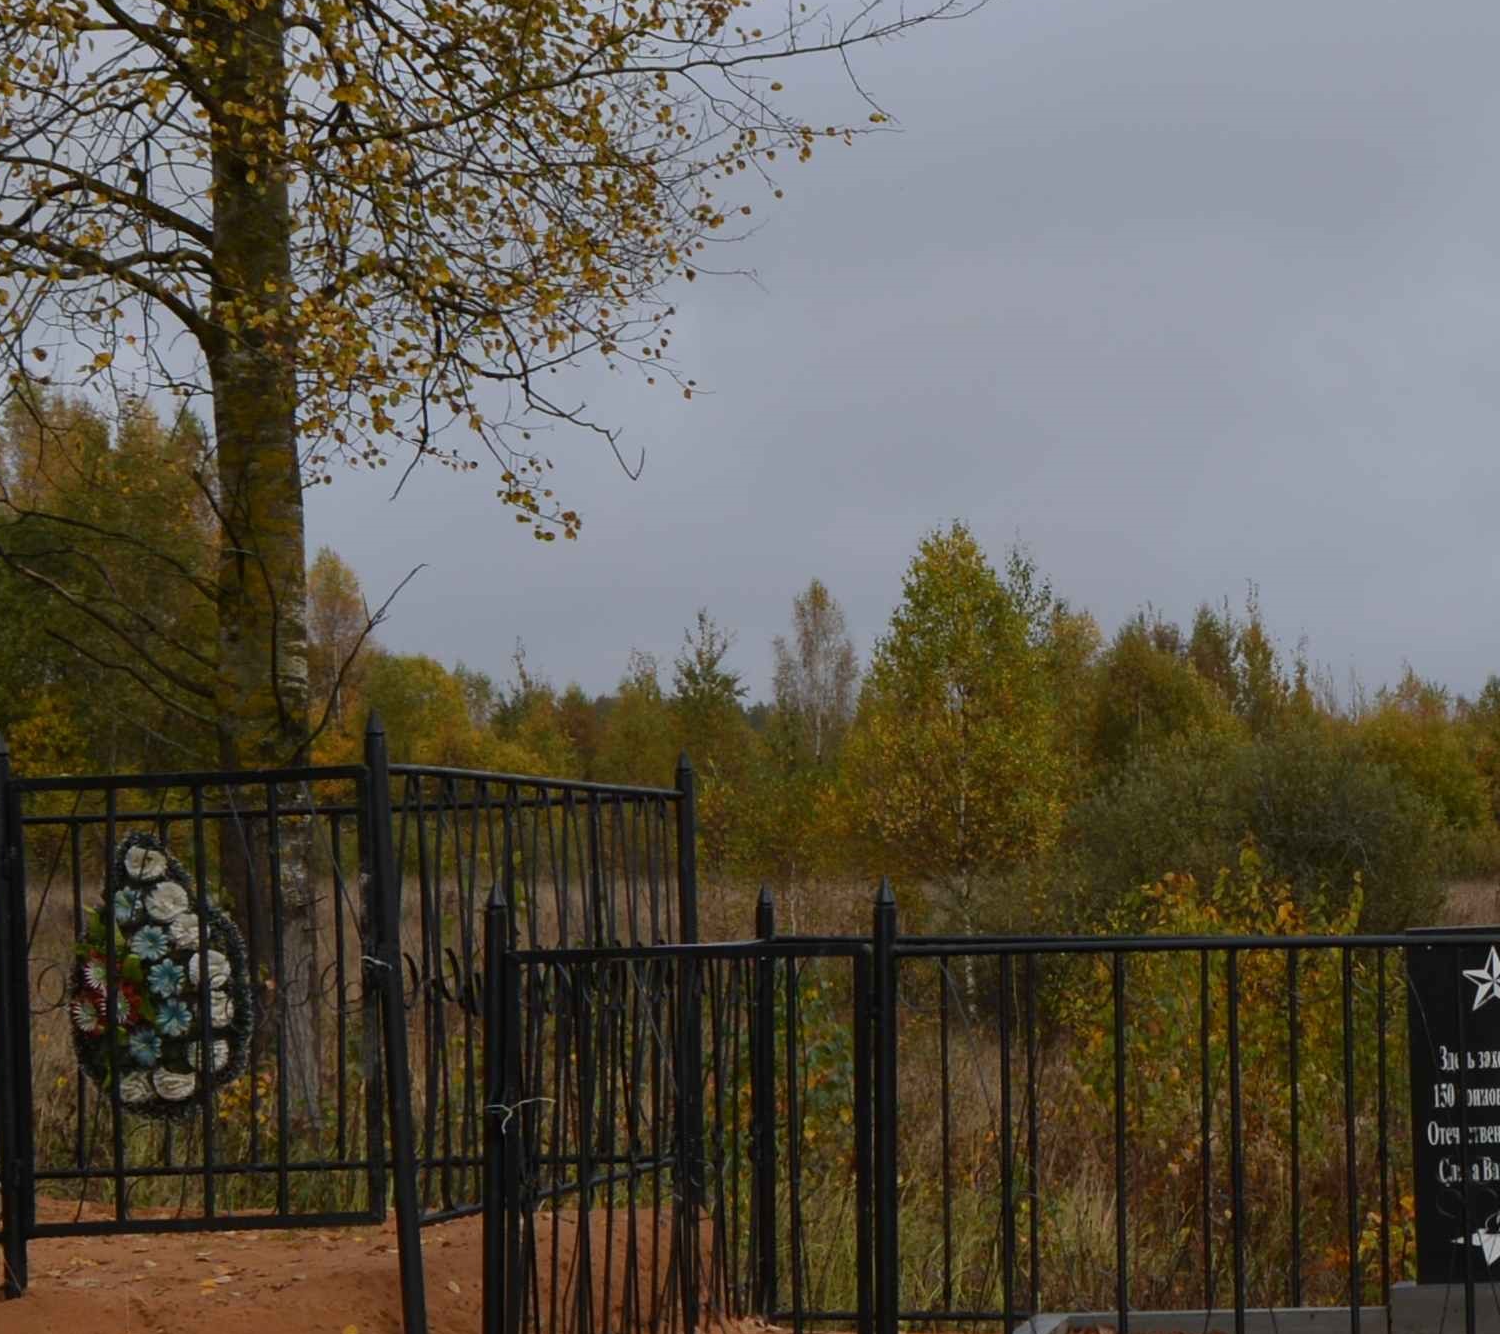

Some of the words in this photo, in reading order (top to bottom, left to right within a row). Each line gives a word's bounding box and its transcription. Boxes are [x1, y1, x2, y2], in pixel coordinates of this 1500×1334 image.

[1438, 1044, 1475, 1071] Здь
[1433, 1082, 1456, 1108] 150
[1438, 1156, 1479, 1185] Сла
